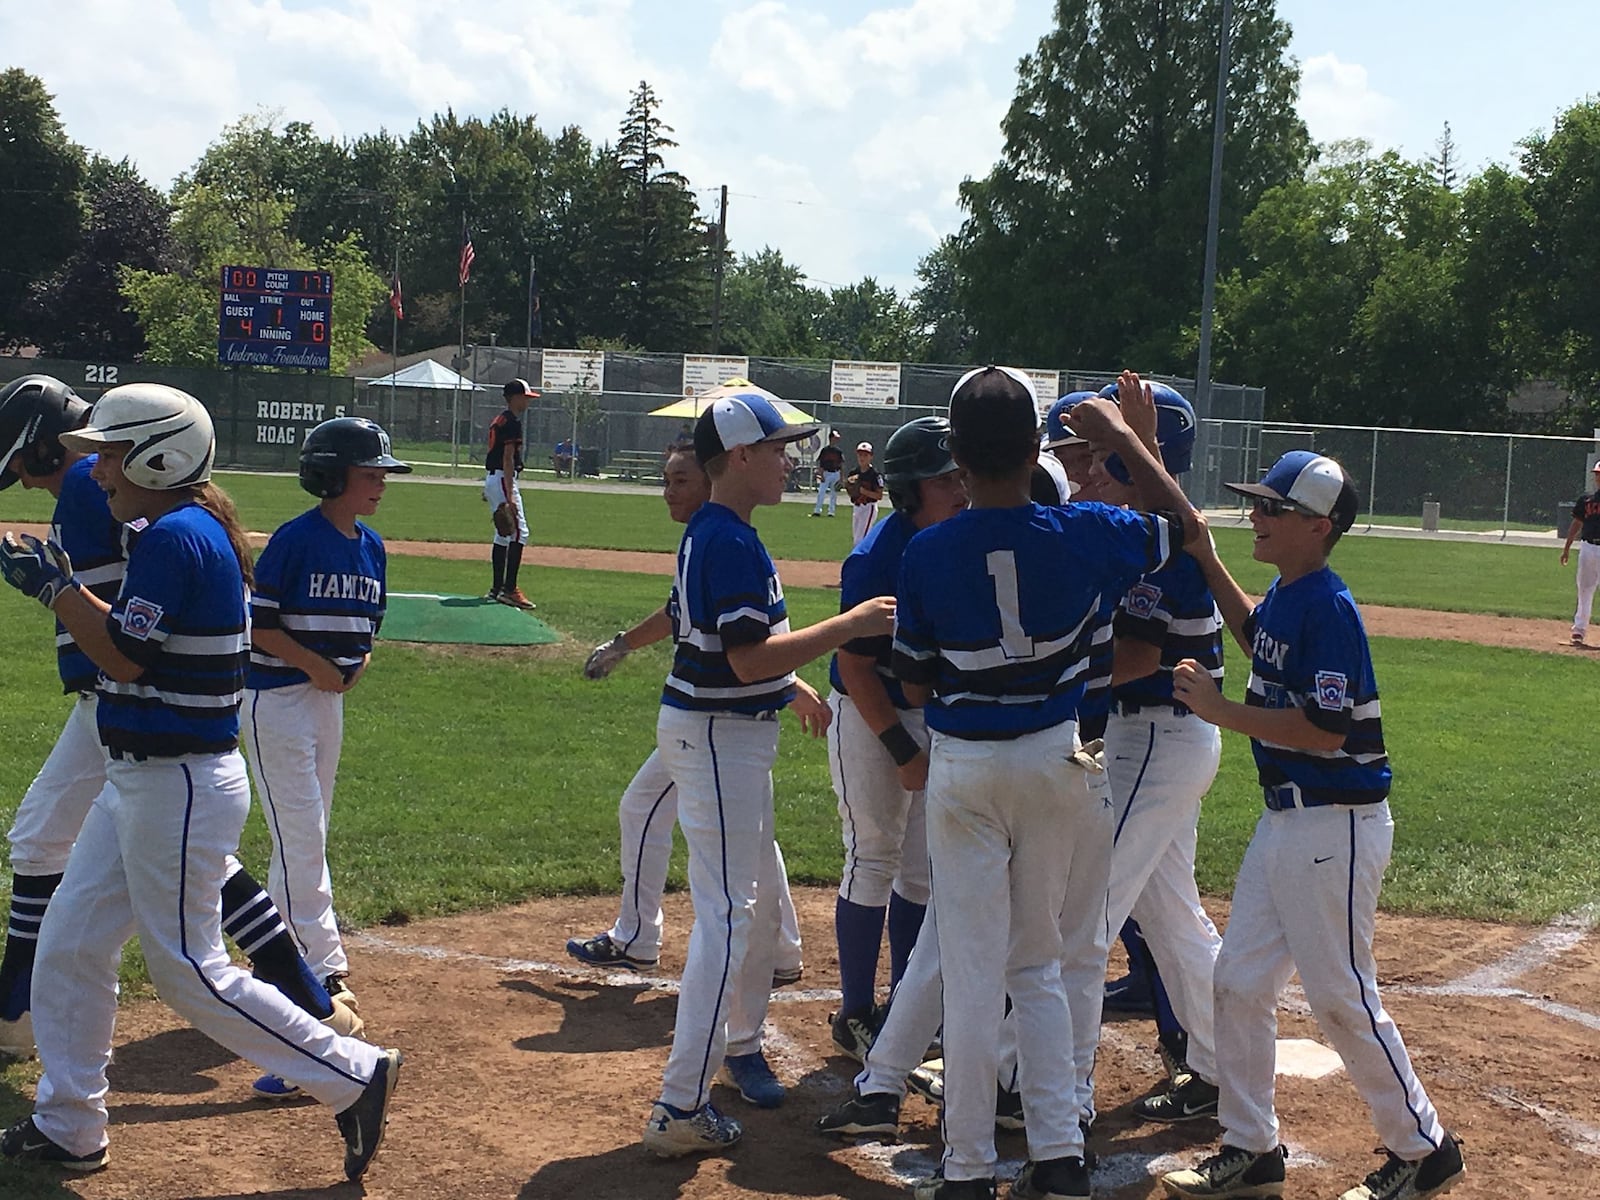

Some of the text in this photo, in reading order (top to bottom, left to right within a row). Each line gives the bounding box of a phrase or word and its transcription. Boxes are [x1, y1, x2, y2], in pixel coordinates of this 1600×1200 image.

[267, 272, 289, 281] PITCH
[304, 275, 321, 290] 17
[265, 281, 289, 289] COUNT
[224, 293, 240, 302] BALL
[260, 295, 283, 305] STRIKE
[300, 298, 315, 306] OUT
[225, 306, 254, 317] GUEST
[276, 308, 283, 325] 1
[300, 310, 325, 321] HOME
[240, 319, 252, 336] 4
[259, 329, 292, 340] INNING
[312, 322, 324, 342] 0
[226, 343, 328, 367] Anderson Foundation
[85, 364, 118, 383] 212
[256, 400, 325, 421] ROBERT
[256, 425, 295, 444] HOAG
[986, 549, 1035, 659] 1
